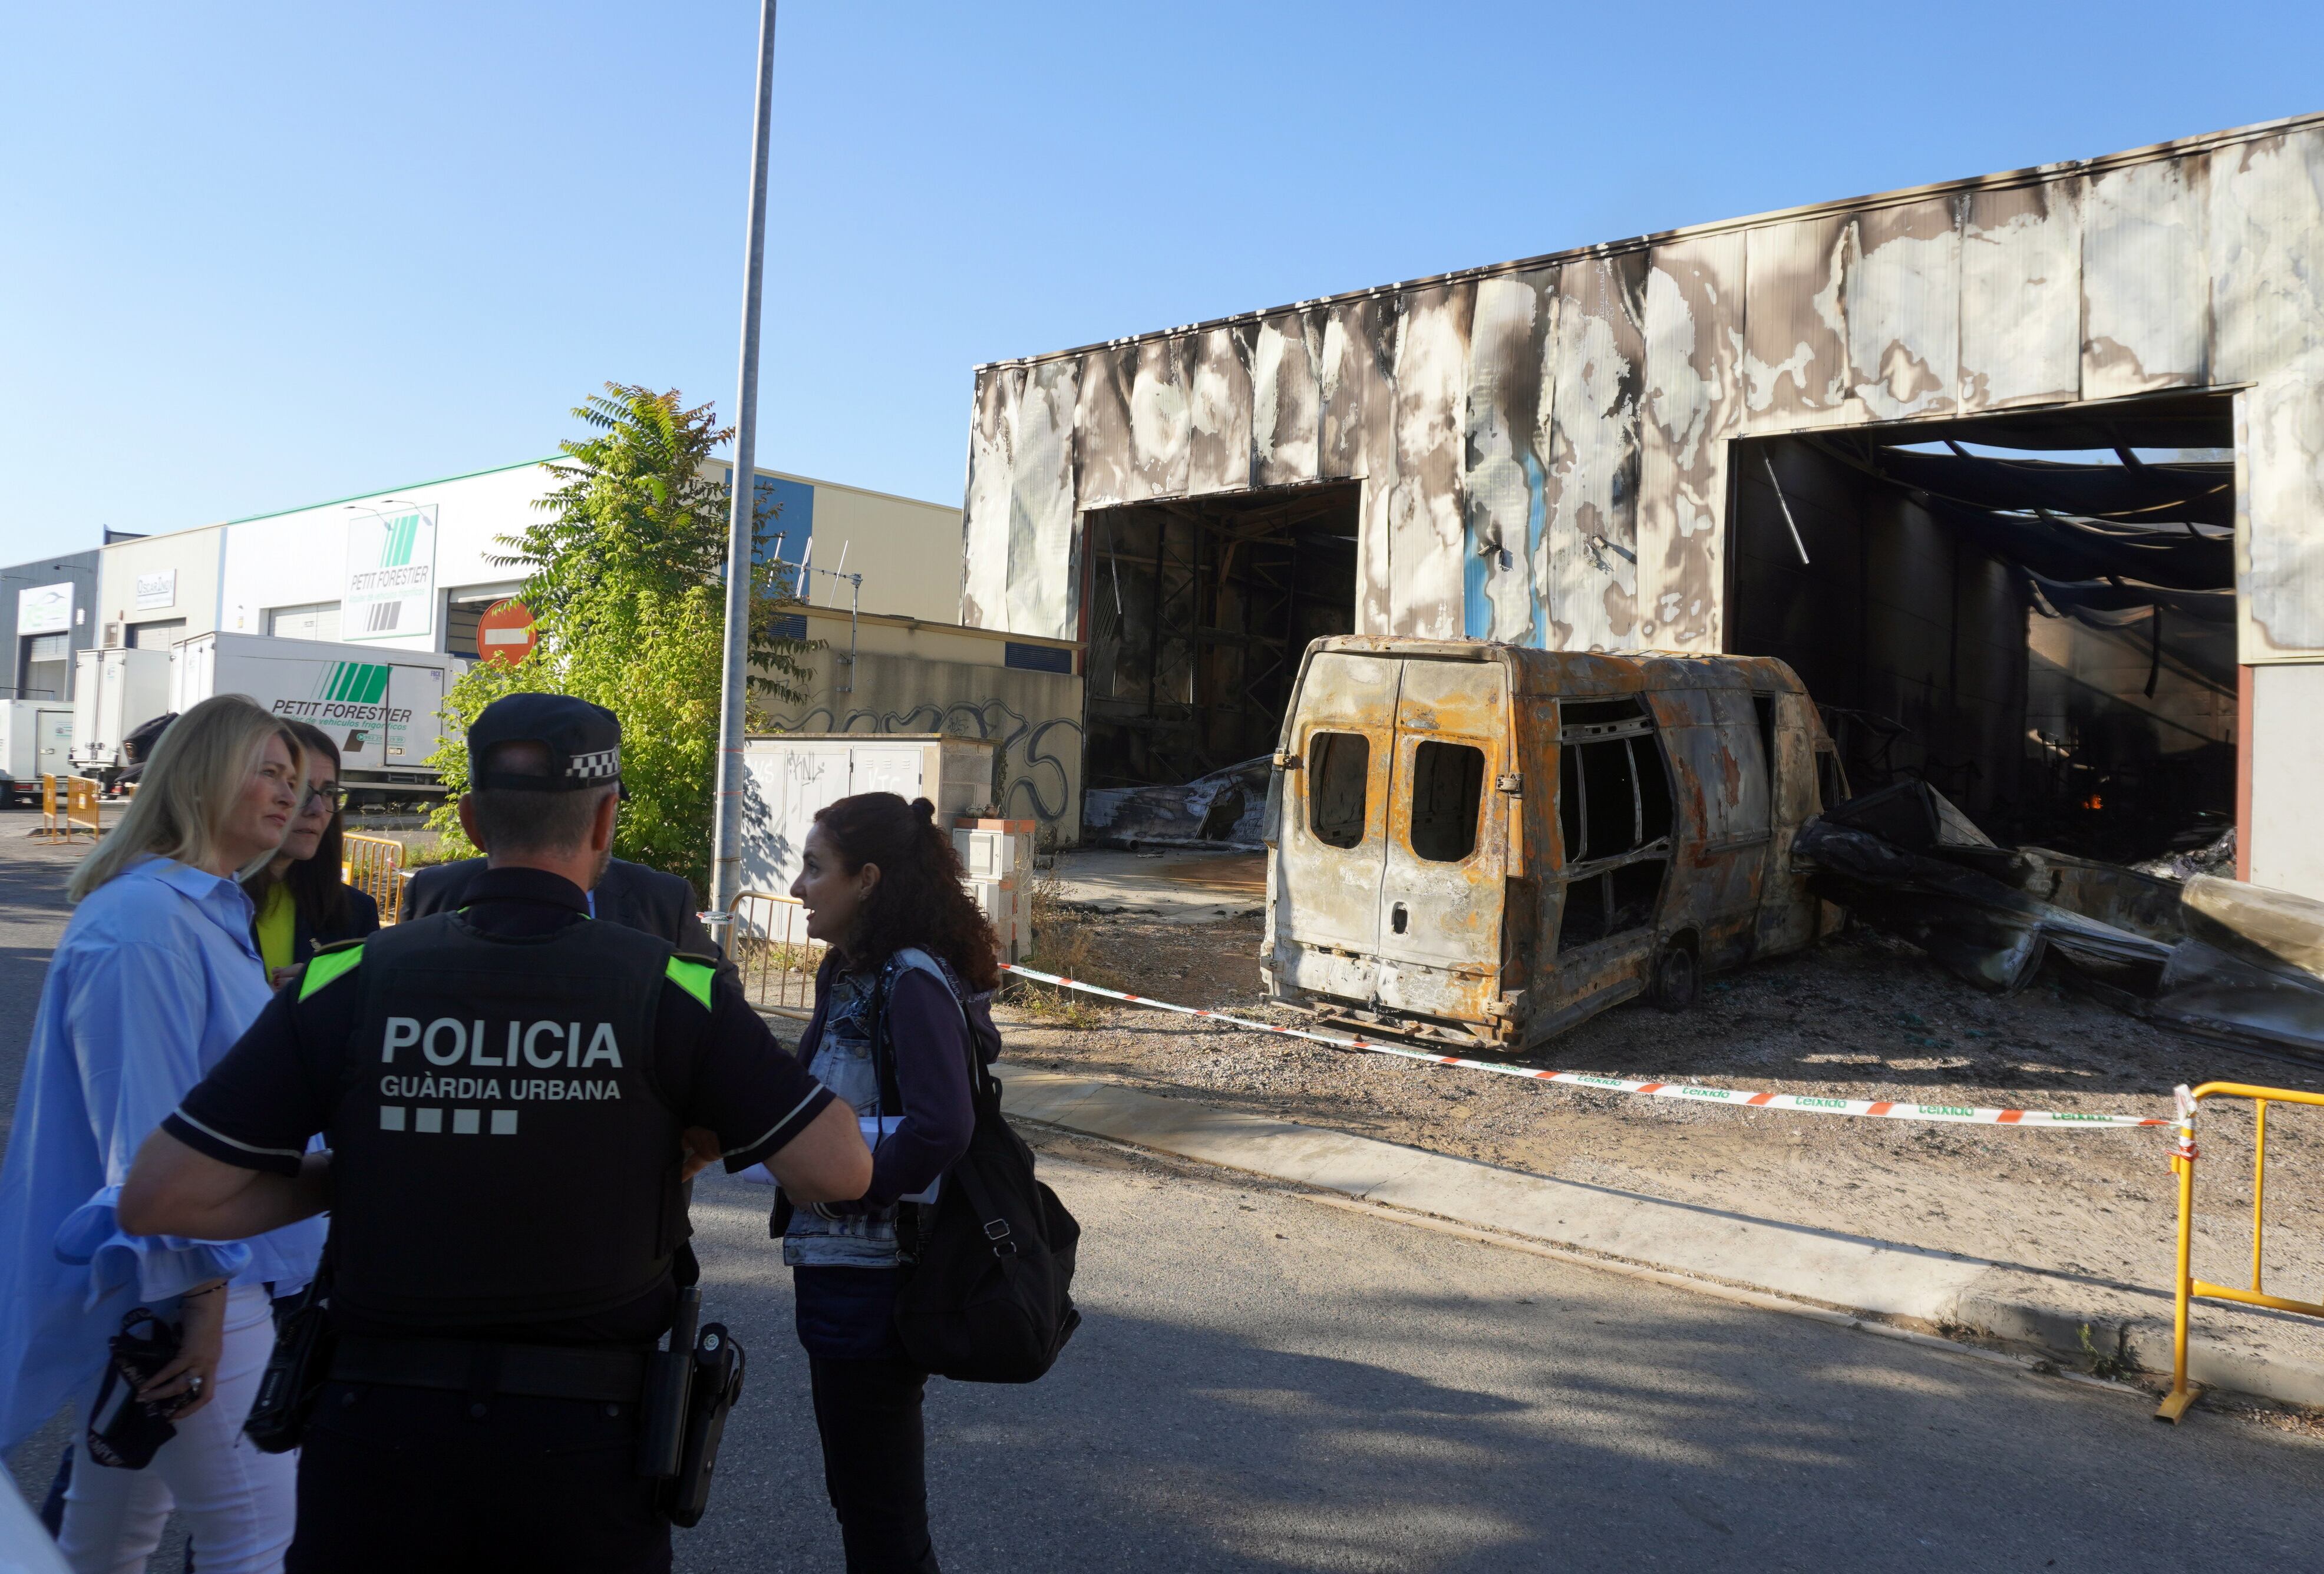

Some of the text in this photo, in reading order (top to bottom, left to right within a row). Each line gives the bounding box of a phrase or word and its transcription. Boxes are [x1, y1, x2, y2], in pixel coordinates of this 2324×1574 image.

[350, 566, 428, 591] PETIT FORESTIER
[272, 699, 412, 723] PETIT FORESTIER
[362, 720, 407, 730] frigorficos
[381, 1016, 623, 1069] POLICIA
[380, 1071, 621, 1100] GUÀRDIA URBANA
